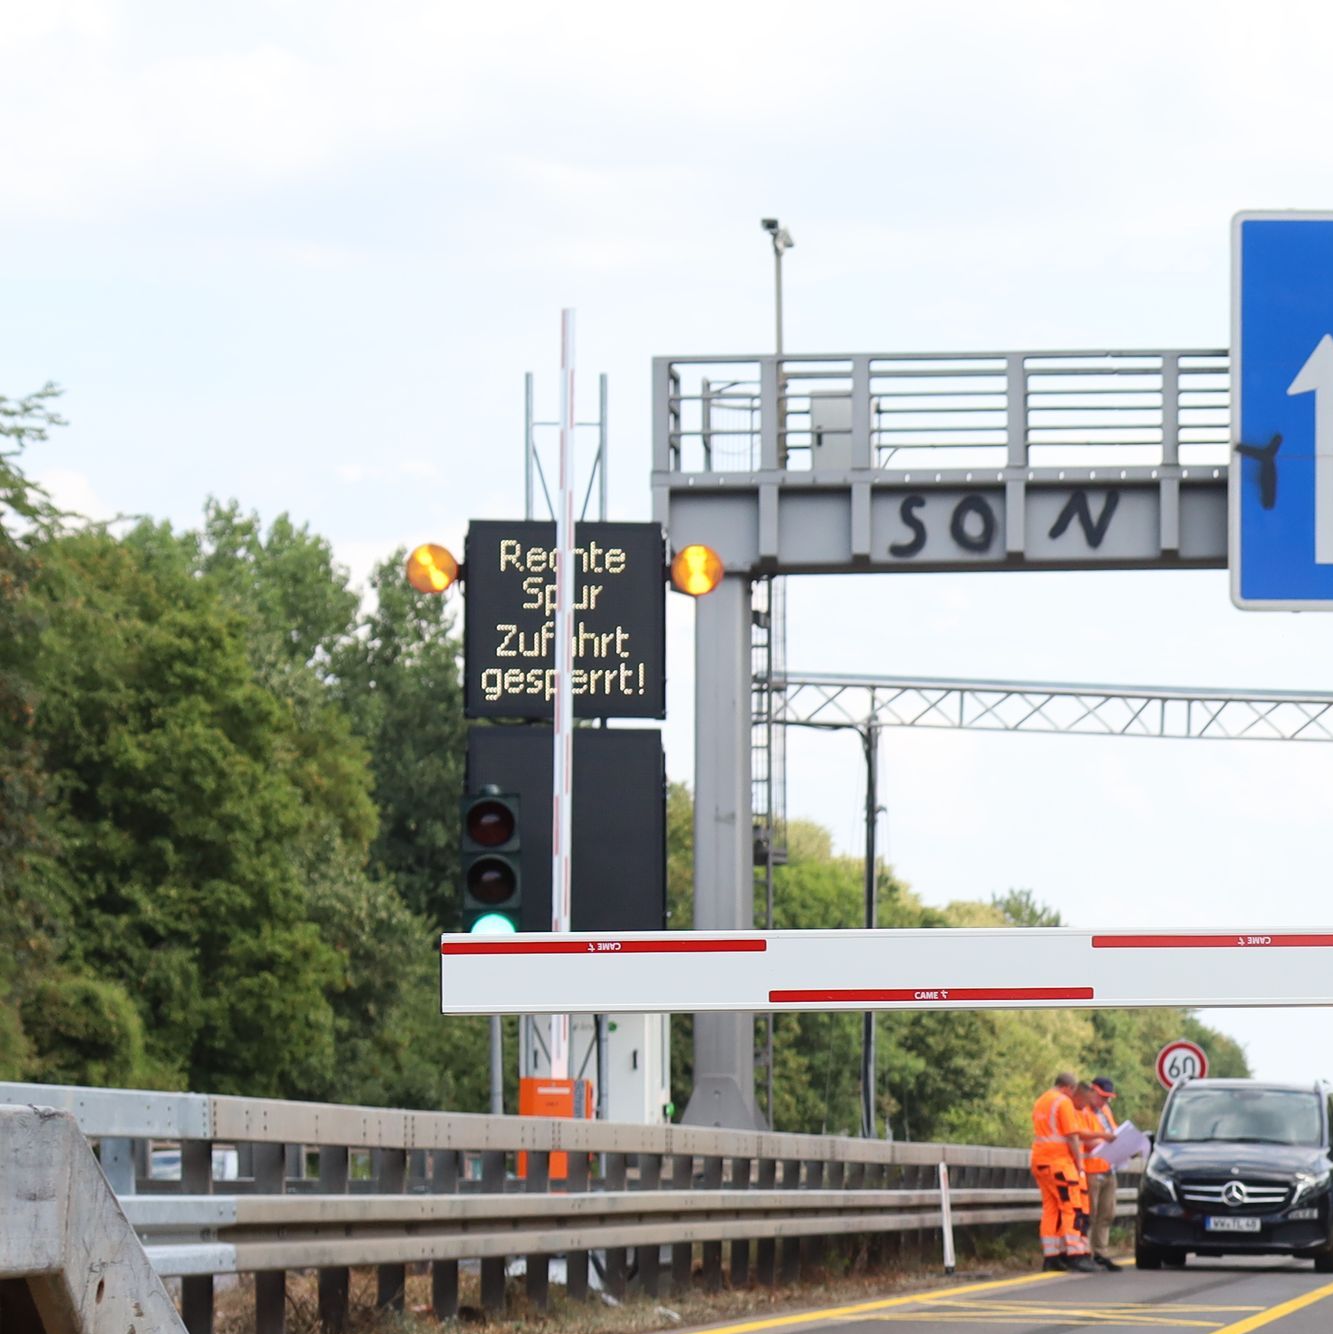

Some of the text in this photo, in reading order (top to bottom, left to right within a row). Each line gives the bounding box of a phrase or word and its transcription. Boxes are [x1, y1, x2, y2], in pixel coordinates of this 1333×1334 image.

[1247, 936, 1272, 944] CAME
[597, 942, 622, 951] CAME
[914, 991, 939, 999] CAME
[1168, 1055, 1196, 1079] 60
